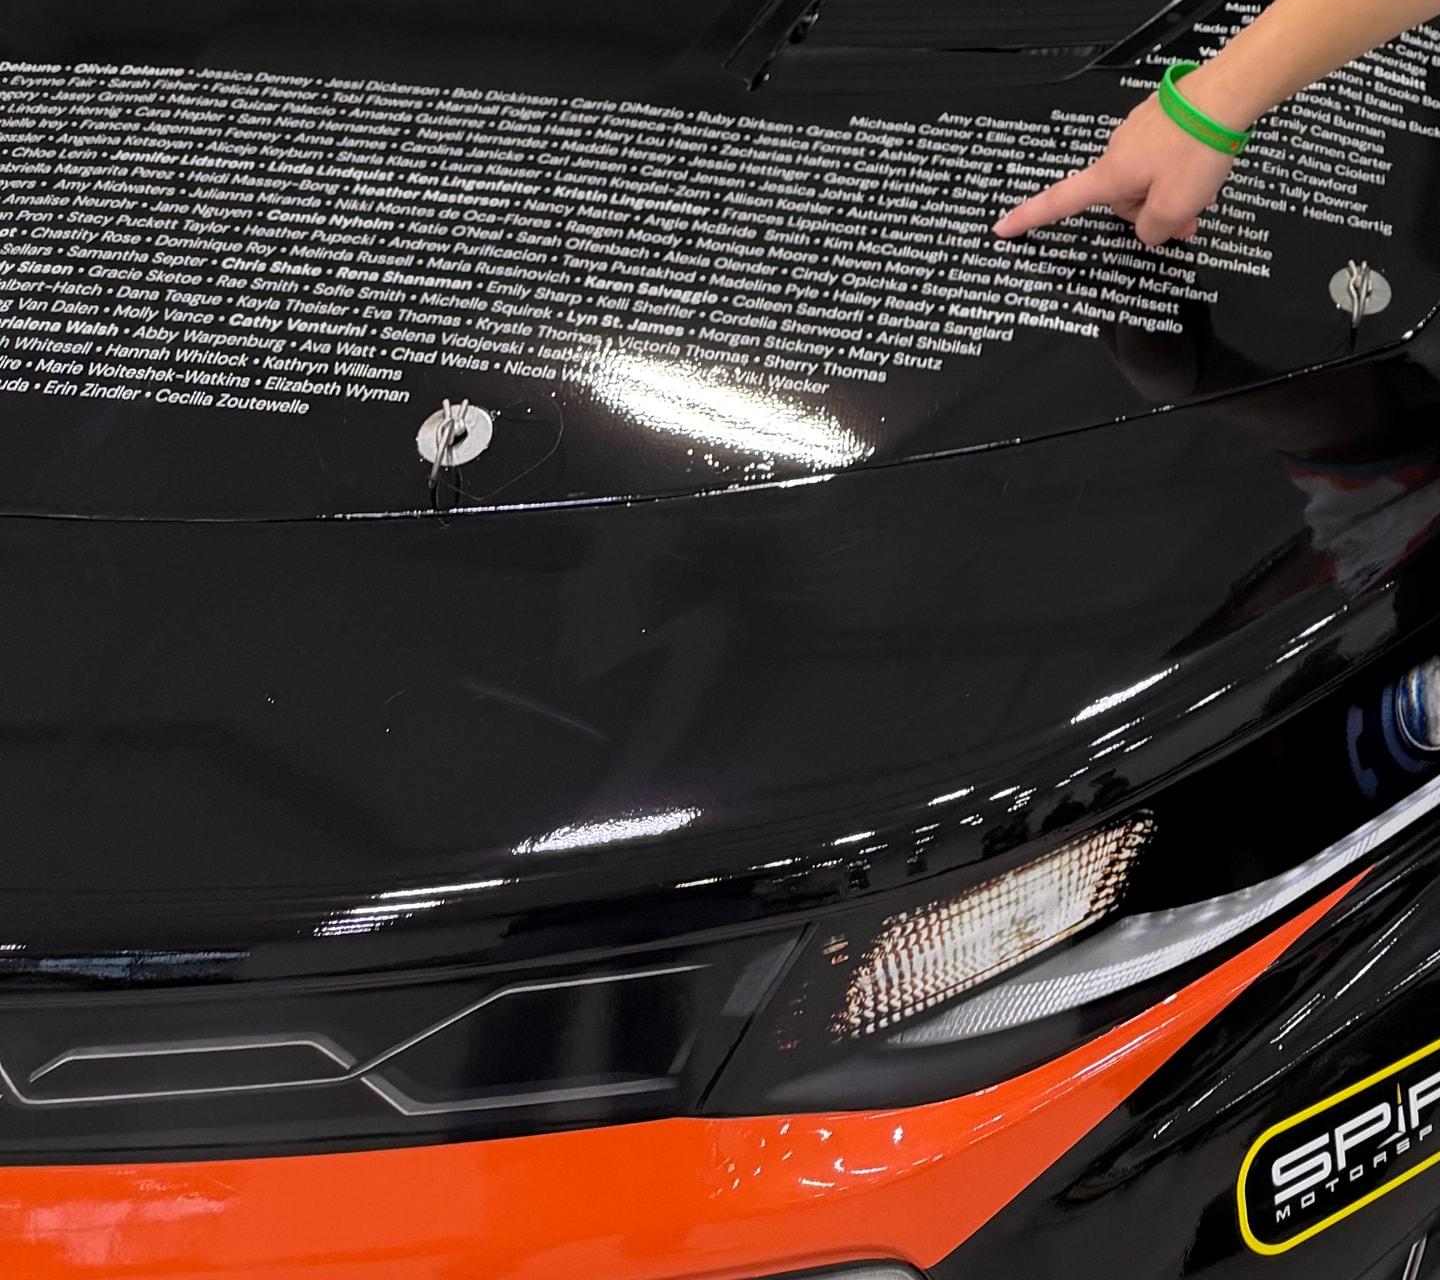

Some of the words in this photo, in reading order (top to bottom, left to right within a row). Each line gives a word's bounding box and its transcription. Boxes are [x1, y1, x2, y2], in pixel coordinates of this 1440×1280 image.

[30, 227, 100, 243] Chastity
[100, 231, 142, 244] Rose
[426, 257, 472, 272] Maria
[876, 313, 941, 331] Barbara
[66, 212, 115, 227] Stacy
[182, 219, 231, 234] Taylor
[832, 290, 882, 308] Hailey
[948, 304, 1016, 324] Kathryn
[1017, 312, 1100, 337] Reinhardt
[149, 201, 190, 213] Jane
[191, 204, 253, 219] Nguyen
[266, 210, 327, 224] Connie
[328, 214, 395, 230] Nyholm
[1071, 302, 1116, 321] Alana
[1118, 311, 1183, 333] Pangallo
[220, 257, 267, 271] Chris
[269, 261, 323, 276] Shake
[485, 281, 532, 299] Emily
[533, 287, 583, 306] Sharp
[875, 331, 914, 347] Ariel
[14, 337, 94, 354] Whitesell
[104, 344, 171, 360] Hannah
[175, 349, 249, 366] Whitlock
[262, 356, 329, 374] Kathryn
[333, 362, 403, 380] Williams
[16, 261, 74, 275] Sisson
[87, 265, 143, 280] Gracie
[215, 275, 248, 288] Rae
[250, 278, 299, 292] Smith
[419, 292, 489, 310] Michelle
[566, 310, 599, 326] Lyn
[600, 315, 624, 328] St.
[626, 319, 685, 336] James
[847, 346, 891, 365] Mary
[892, 352, 943, 369] Strutz
[18, 298, 49, 311] Van
[50, 300, 100, 314] Dalen
[112, 305, 160, 322] Molly
[164, 308, 215, 323] Vance
[228, 314, 284, 332] Cathy
[287, 318, 369, 337] Venturini
[65, 320, 119, 336] Walsh
[132, 326, 180, 343] Abby
[299, 339, 332, 353] Ava
[336, 342, 377, 357] Watt
[390, 348, 438, 363] Chad
[441, 352, 490, 370] Weiss
[115, 286, 160, 300] Dana
[235, 295, 281, 311] Kayla
[362, 306, 393, 319] Eva
[398, 309, 462, 326] Thomas
[763, 355, 819, 375] Sherry
[34, 359, 84, 374] Marie
[264, 377, 342, 395] Elizabeth
[345, 384, 410, 402] Wyman
[43, 380, 78, 395] Erin
[79, 383, 142, 400] Zindler
[155, 389, 214, 405] Cecilia
